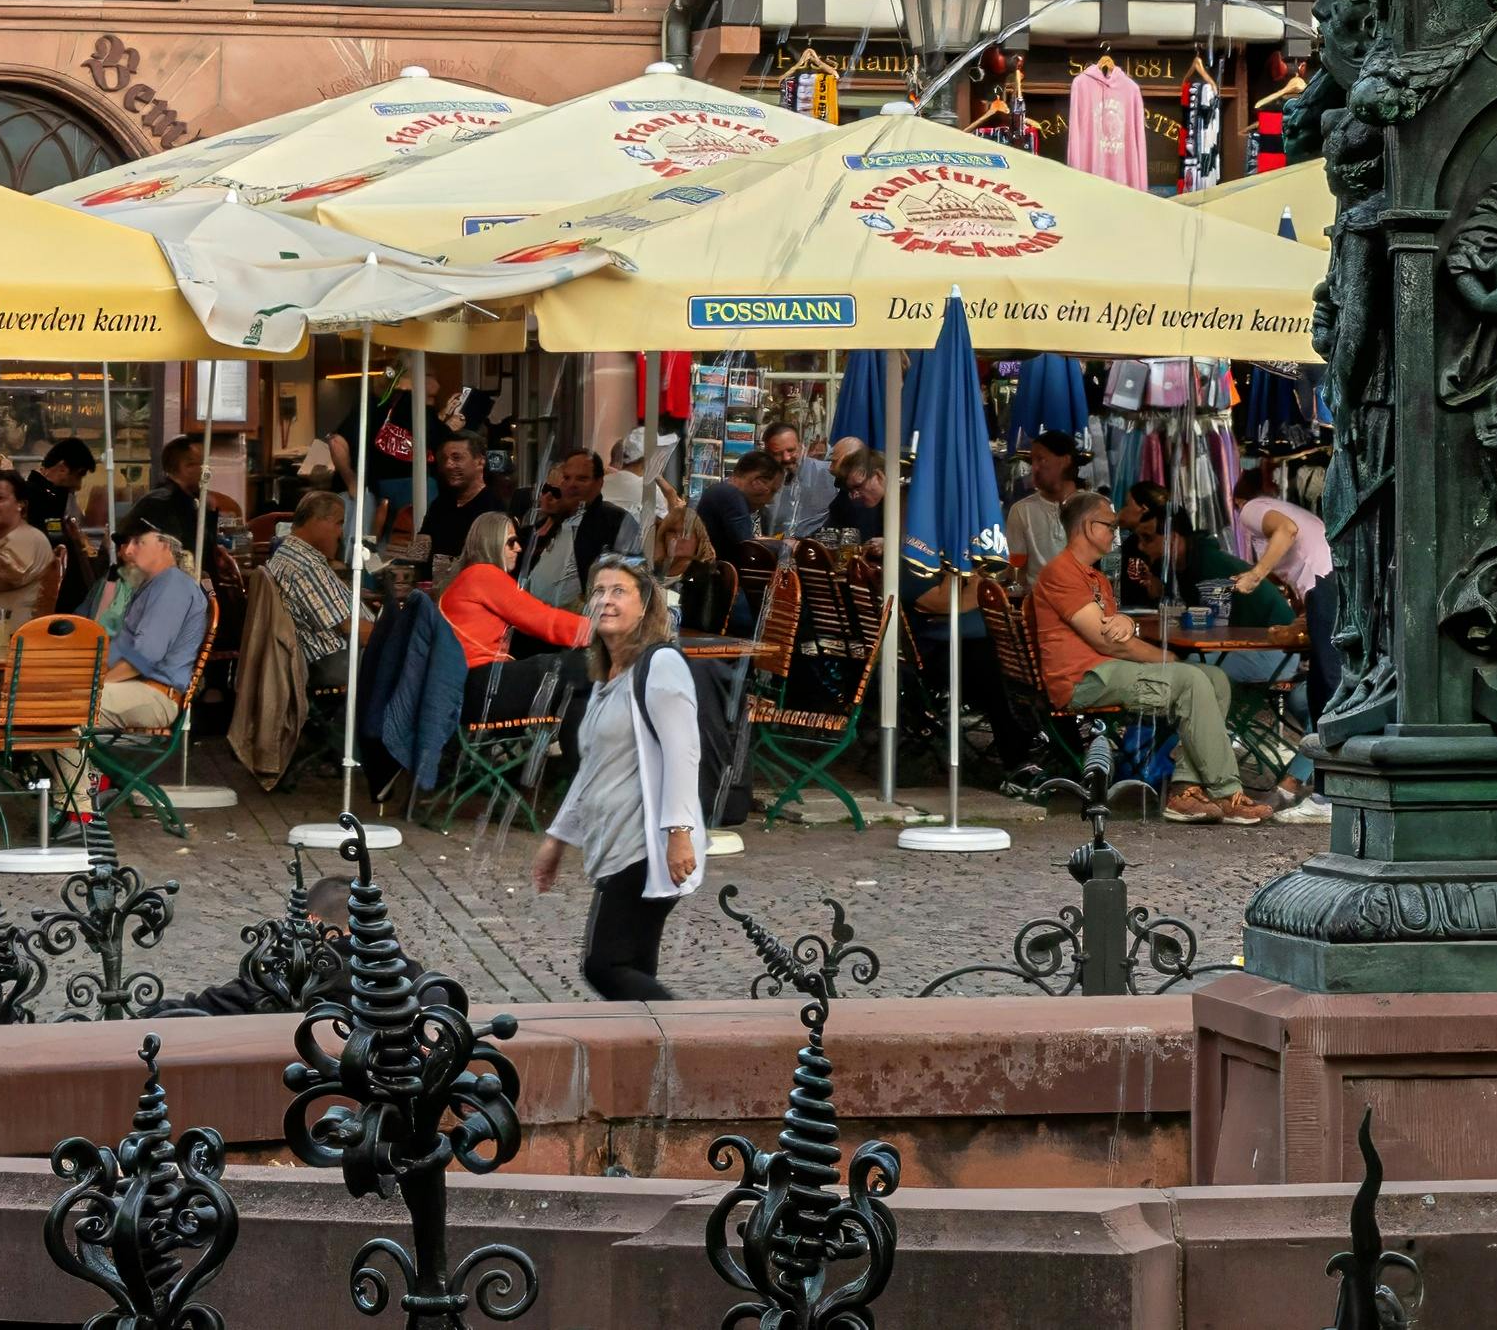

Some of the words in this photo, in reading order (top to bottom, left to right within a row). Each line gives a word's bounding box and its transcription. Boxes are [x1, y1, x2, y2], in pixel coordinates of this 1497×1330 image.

[850, 166, 1043, 211] Frankfurter
[93, 308, 162, 332] kann.
[704, 301, 841, 322] POSSMANN
[888, 297, 933, 320] Das
[1004, 301, 1048, 320] was
[1057, 300, 1090, 323] ein
[1097, 302, 1156, 331] Apfel
[1162, 307, 1243, 331] werden
